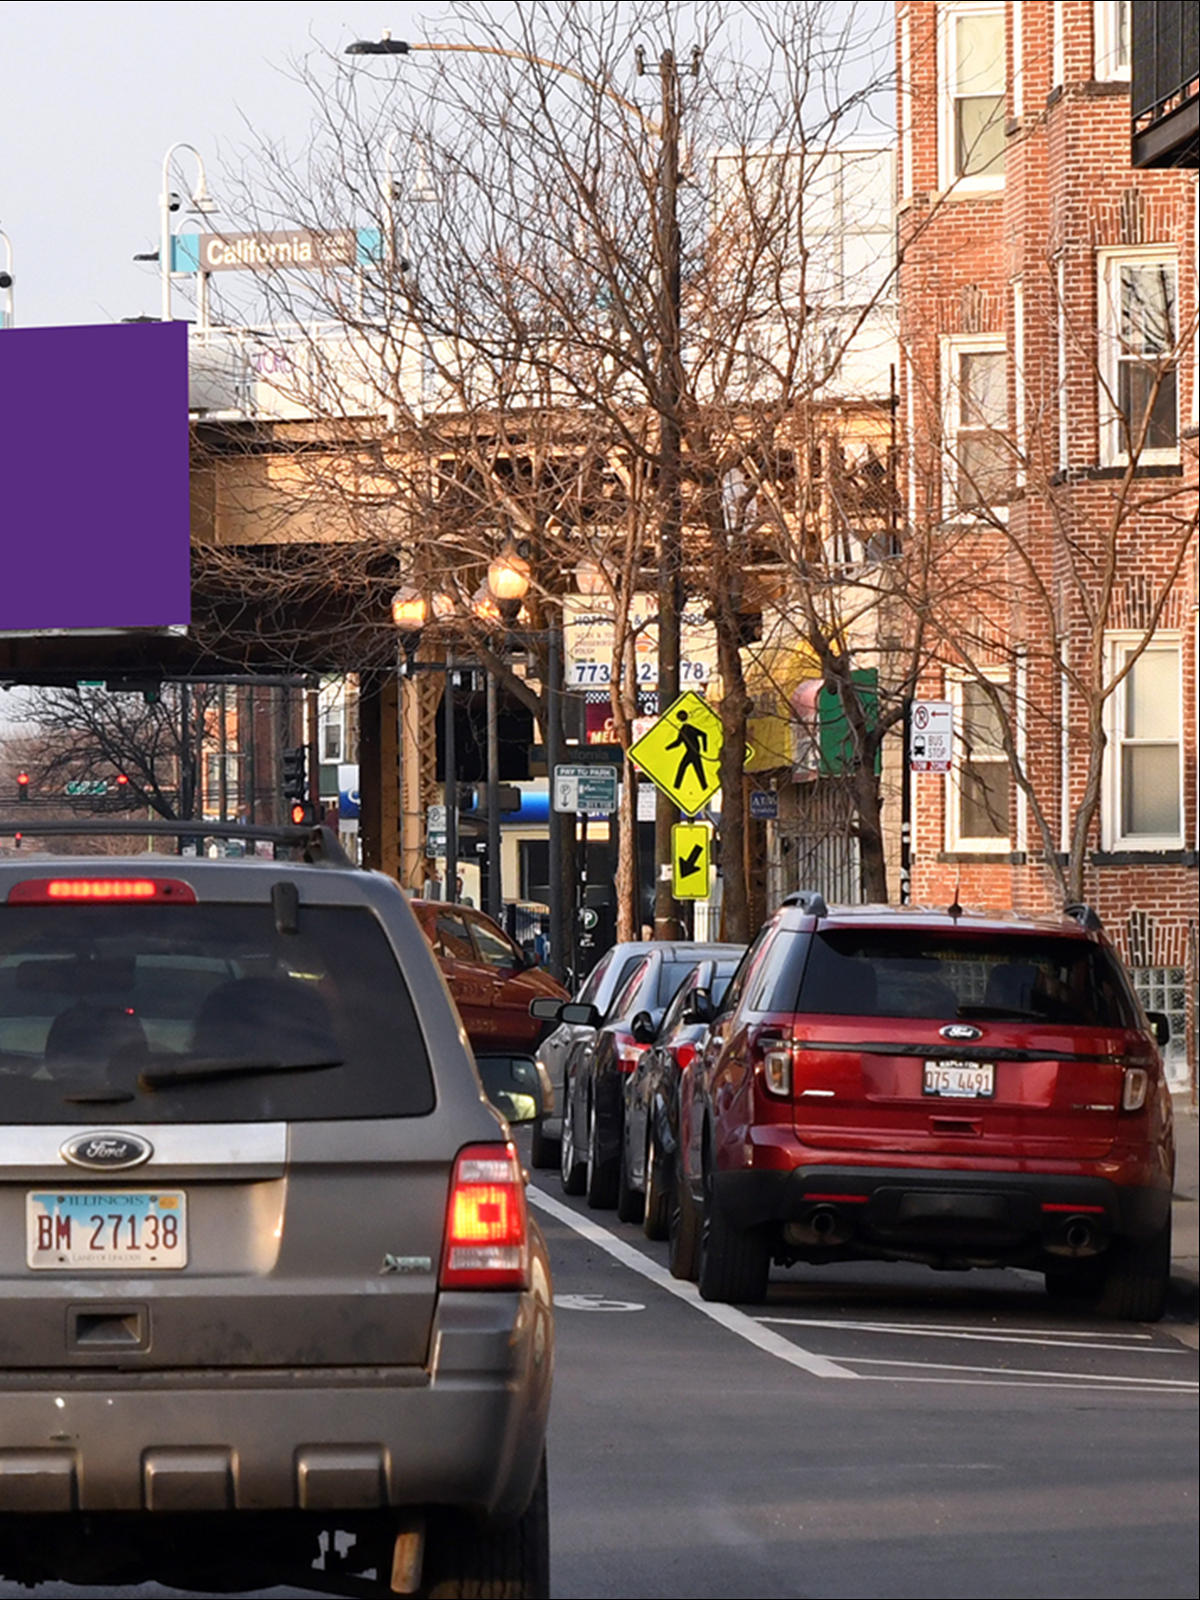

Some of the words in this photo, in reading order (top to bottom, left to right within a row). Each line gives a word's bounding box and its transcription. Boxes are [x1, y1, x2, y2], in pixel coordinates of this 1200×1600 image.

[206, 237, 312, 265] California
[576, 664, 610, 682] 773
[928, 735, 943, 747] BUS
[928, 747, 947, 758] STOP
[560, 768, 575, 776] PAY
[577, 768, 589, 776] TO
[589, 768, 611, 776] PARK
[957, 1073, 991, 1092] 4491
[86, 1140, 128, 1158] Ford
[66, 1195, 144, 1206] ILLINOIS
[37, 1214, 71, 1250] BM
[89, 1214, 177, 1250] 27138
